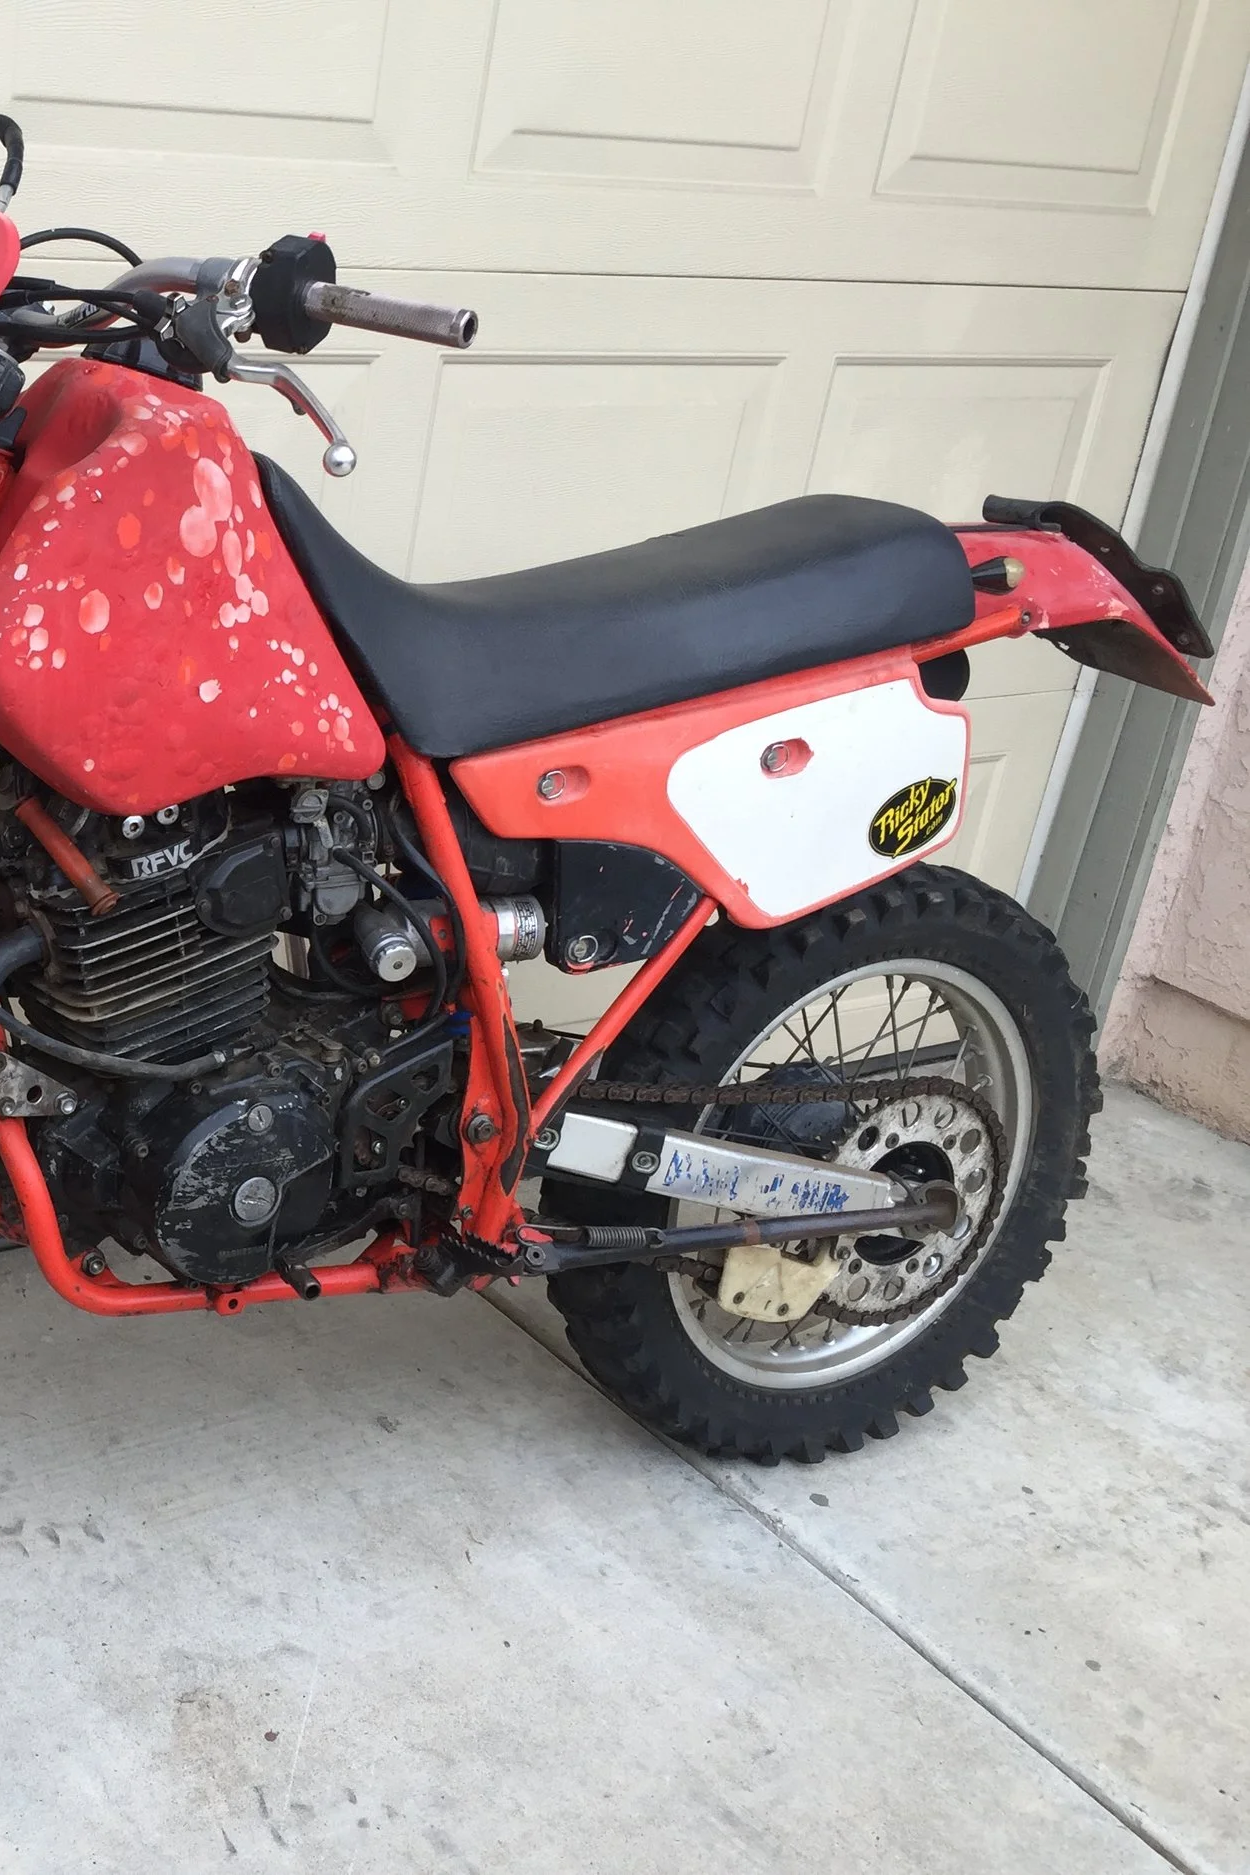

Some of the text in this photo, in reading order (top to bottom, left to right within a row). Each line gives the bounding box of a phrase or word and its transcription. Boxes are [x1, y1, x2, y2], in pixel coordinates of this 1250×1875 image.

[873, 777, 932, 845] Ricky
[892, 779, 956, 858] Stator
[130, 839, 193, 878] RFVC
